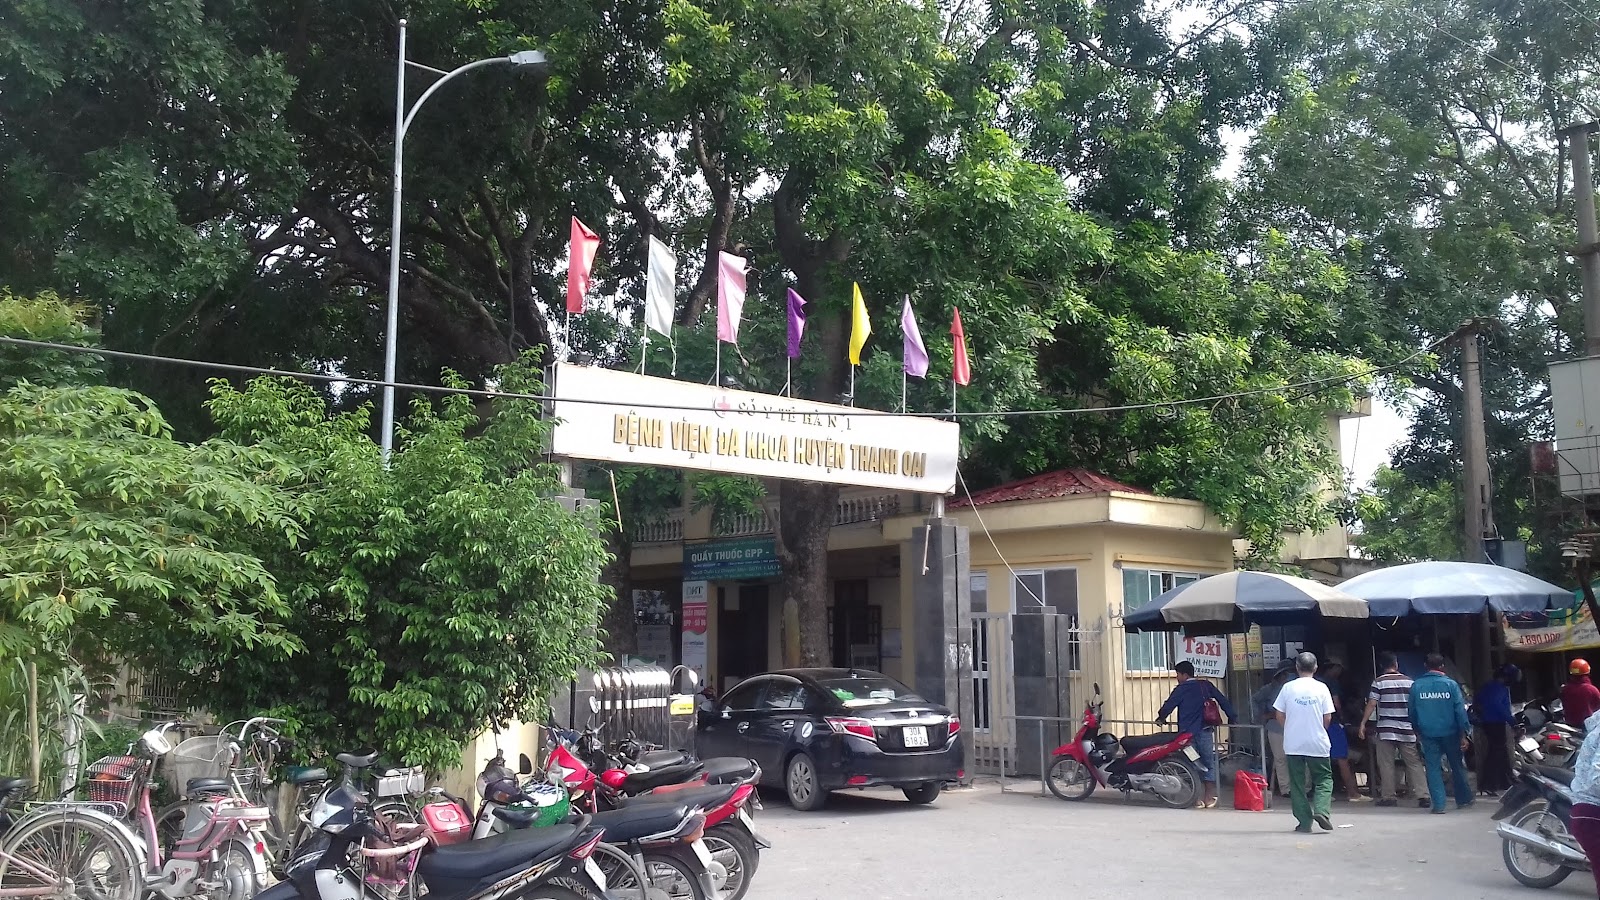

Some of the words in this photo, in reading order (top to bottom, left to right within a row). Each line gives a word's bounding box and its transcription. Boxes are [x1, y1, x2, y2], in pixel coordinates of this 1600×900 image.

[613, 410, 664, 452] BỆNH
[716, 427, 740, 457] ĐA
[745, 430, 789, 463] KHOA
[794, 436, 846, 473] HUYỆN
[850, 444, 899, 475] THANH
[902, 450, 927, 478] OAI
[715, 548, 743, 561] THUỐC
[745, 548, 763, 558] GPP
[1183, 636, 1222, 657] Taxi
[1419, 692, 1451, 700] LILAMA10
[908, 727, 921, 736] 30A
